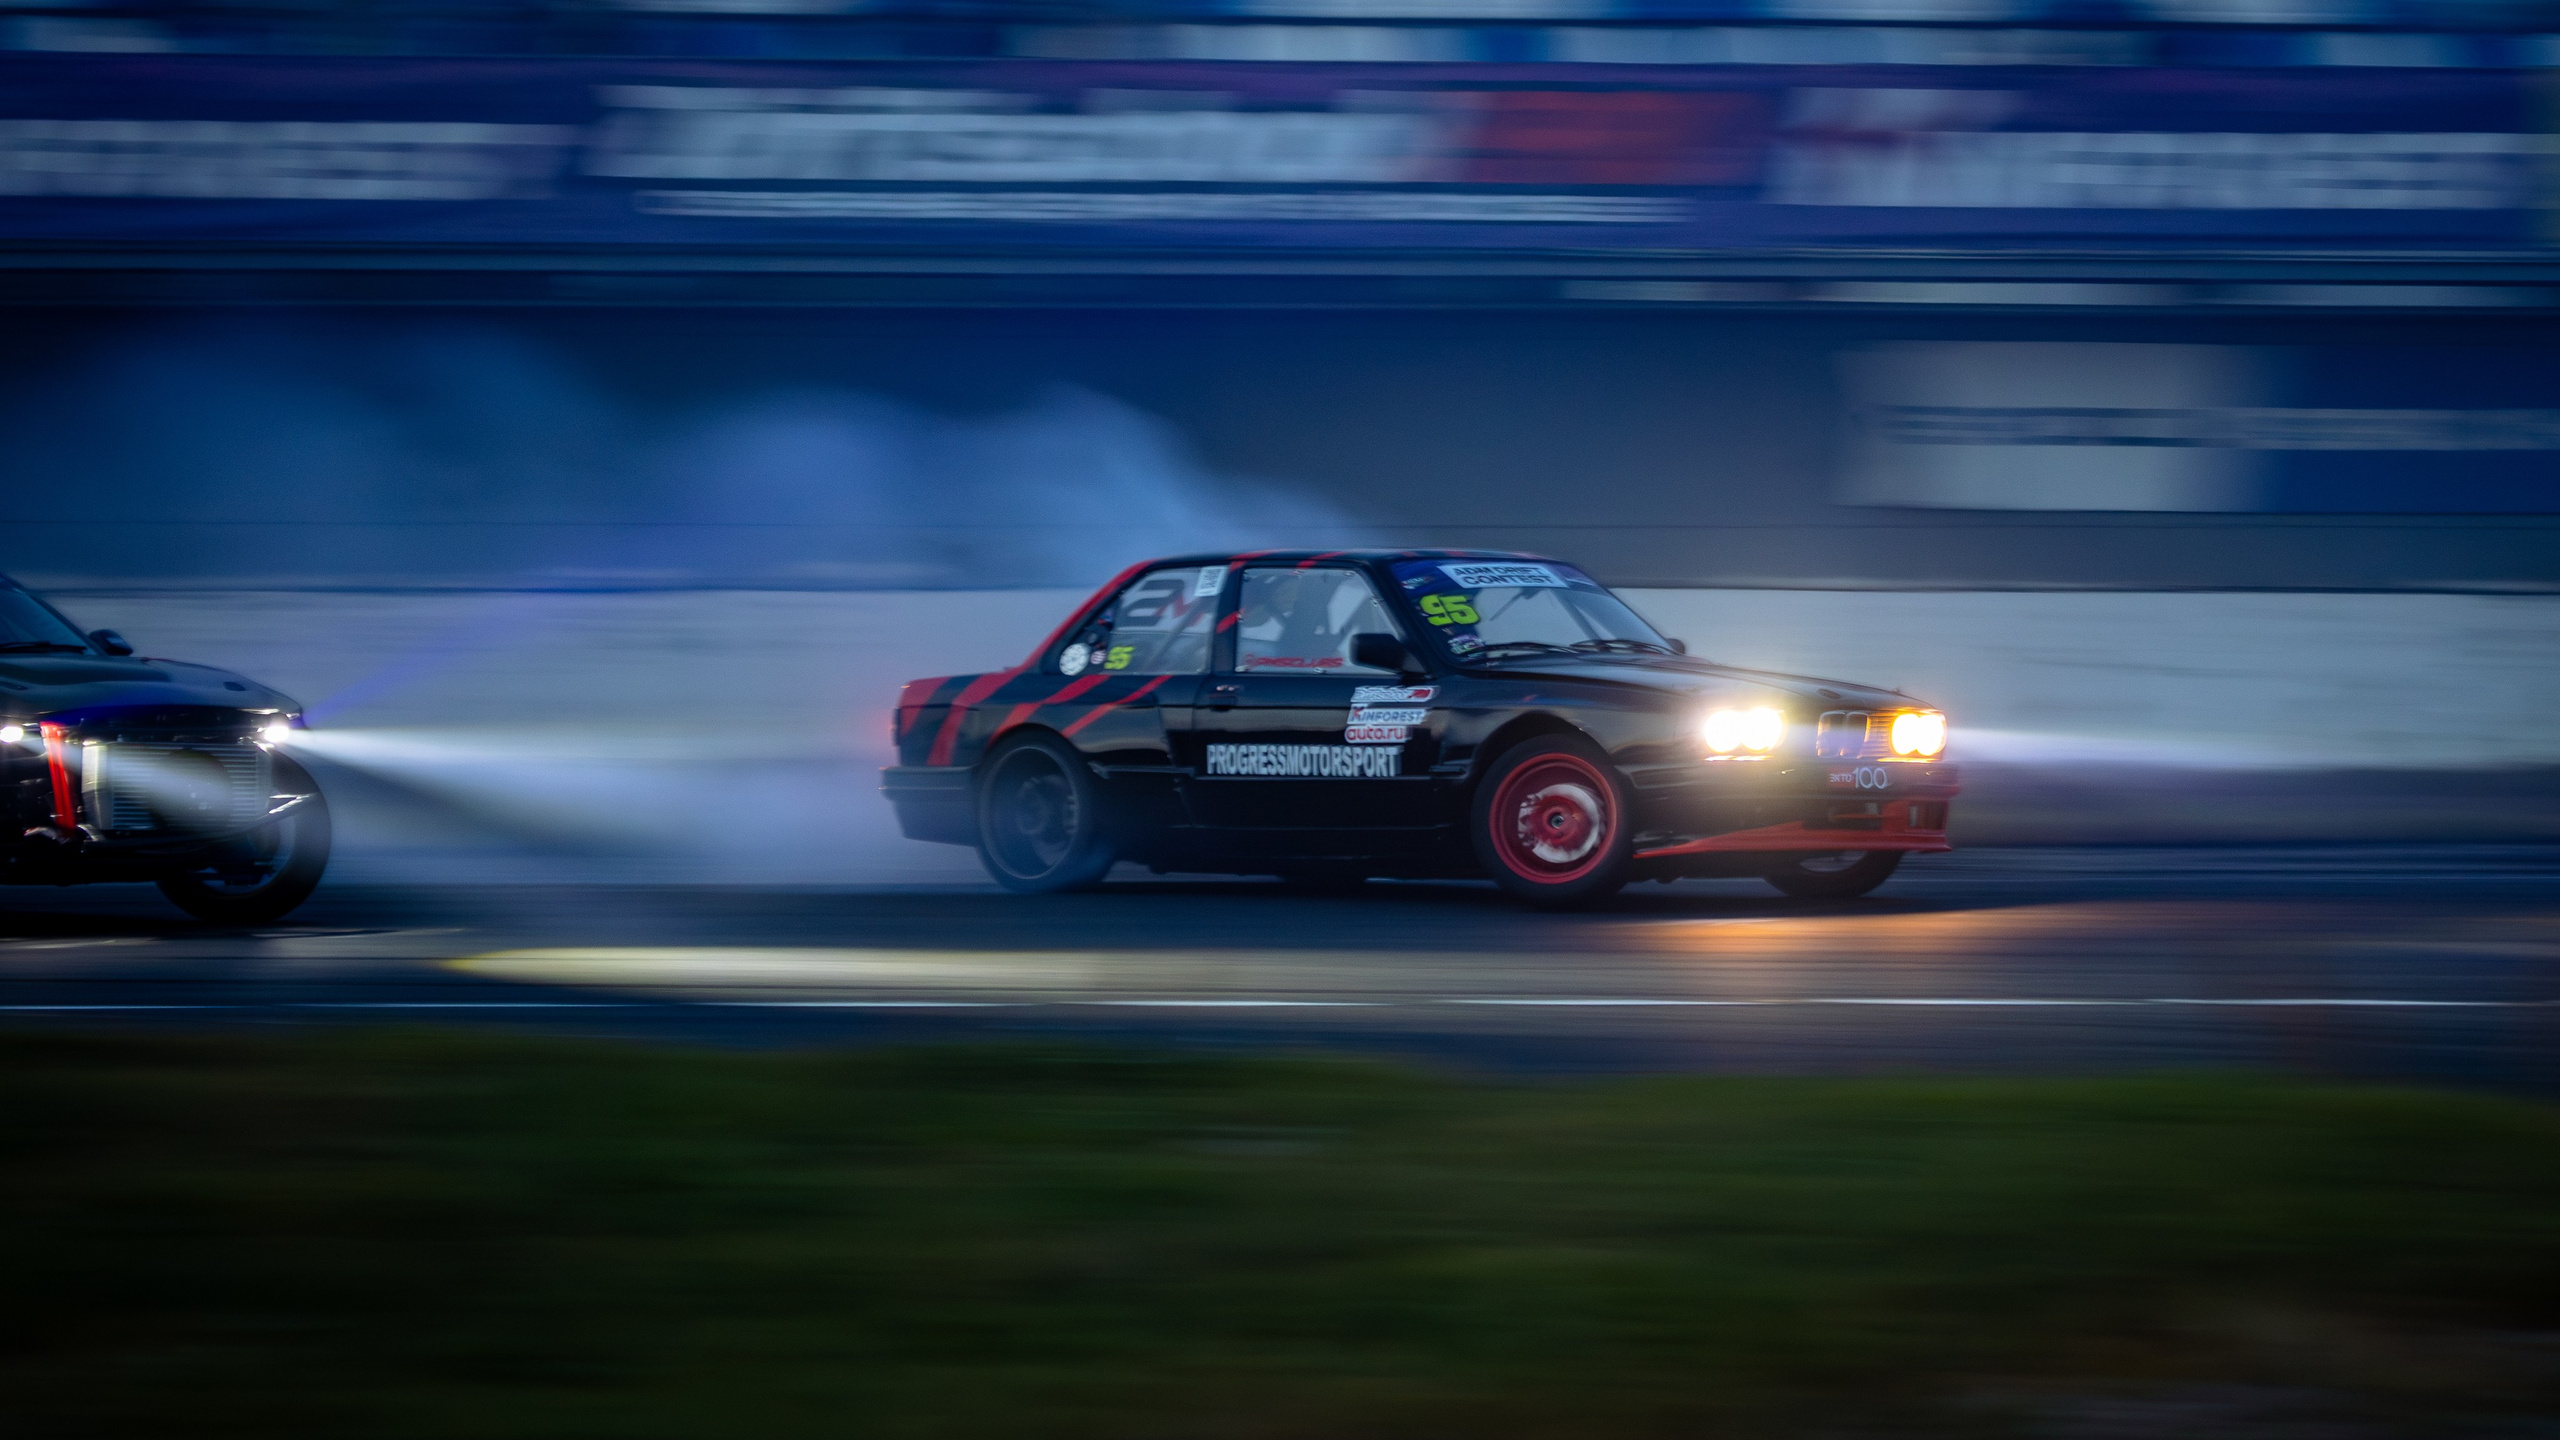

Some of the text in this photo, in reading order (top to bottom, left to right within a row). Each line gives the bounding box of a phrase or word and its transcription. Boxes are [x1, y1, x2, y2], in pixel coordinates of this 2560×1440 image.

[1453, 566, 1545, 576] ADM DRIFT
[1461, 575, 1555, 585] CONTEST
[1419, 594, 1480, 626] 95
[1346, 726, 1405, 741] auto.ru
[1206, 744, 1401, 777] PROGRESSMOTORSPORT
[1852, 767, 1888, 789] 100
